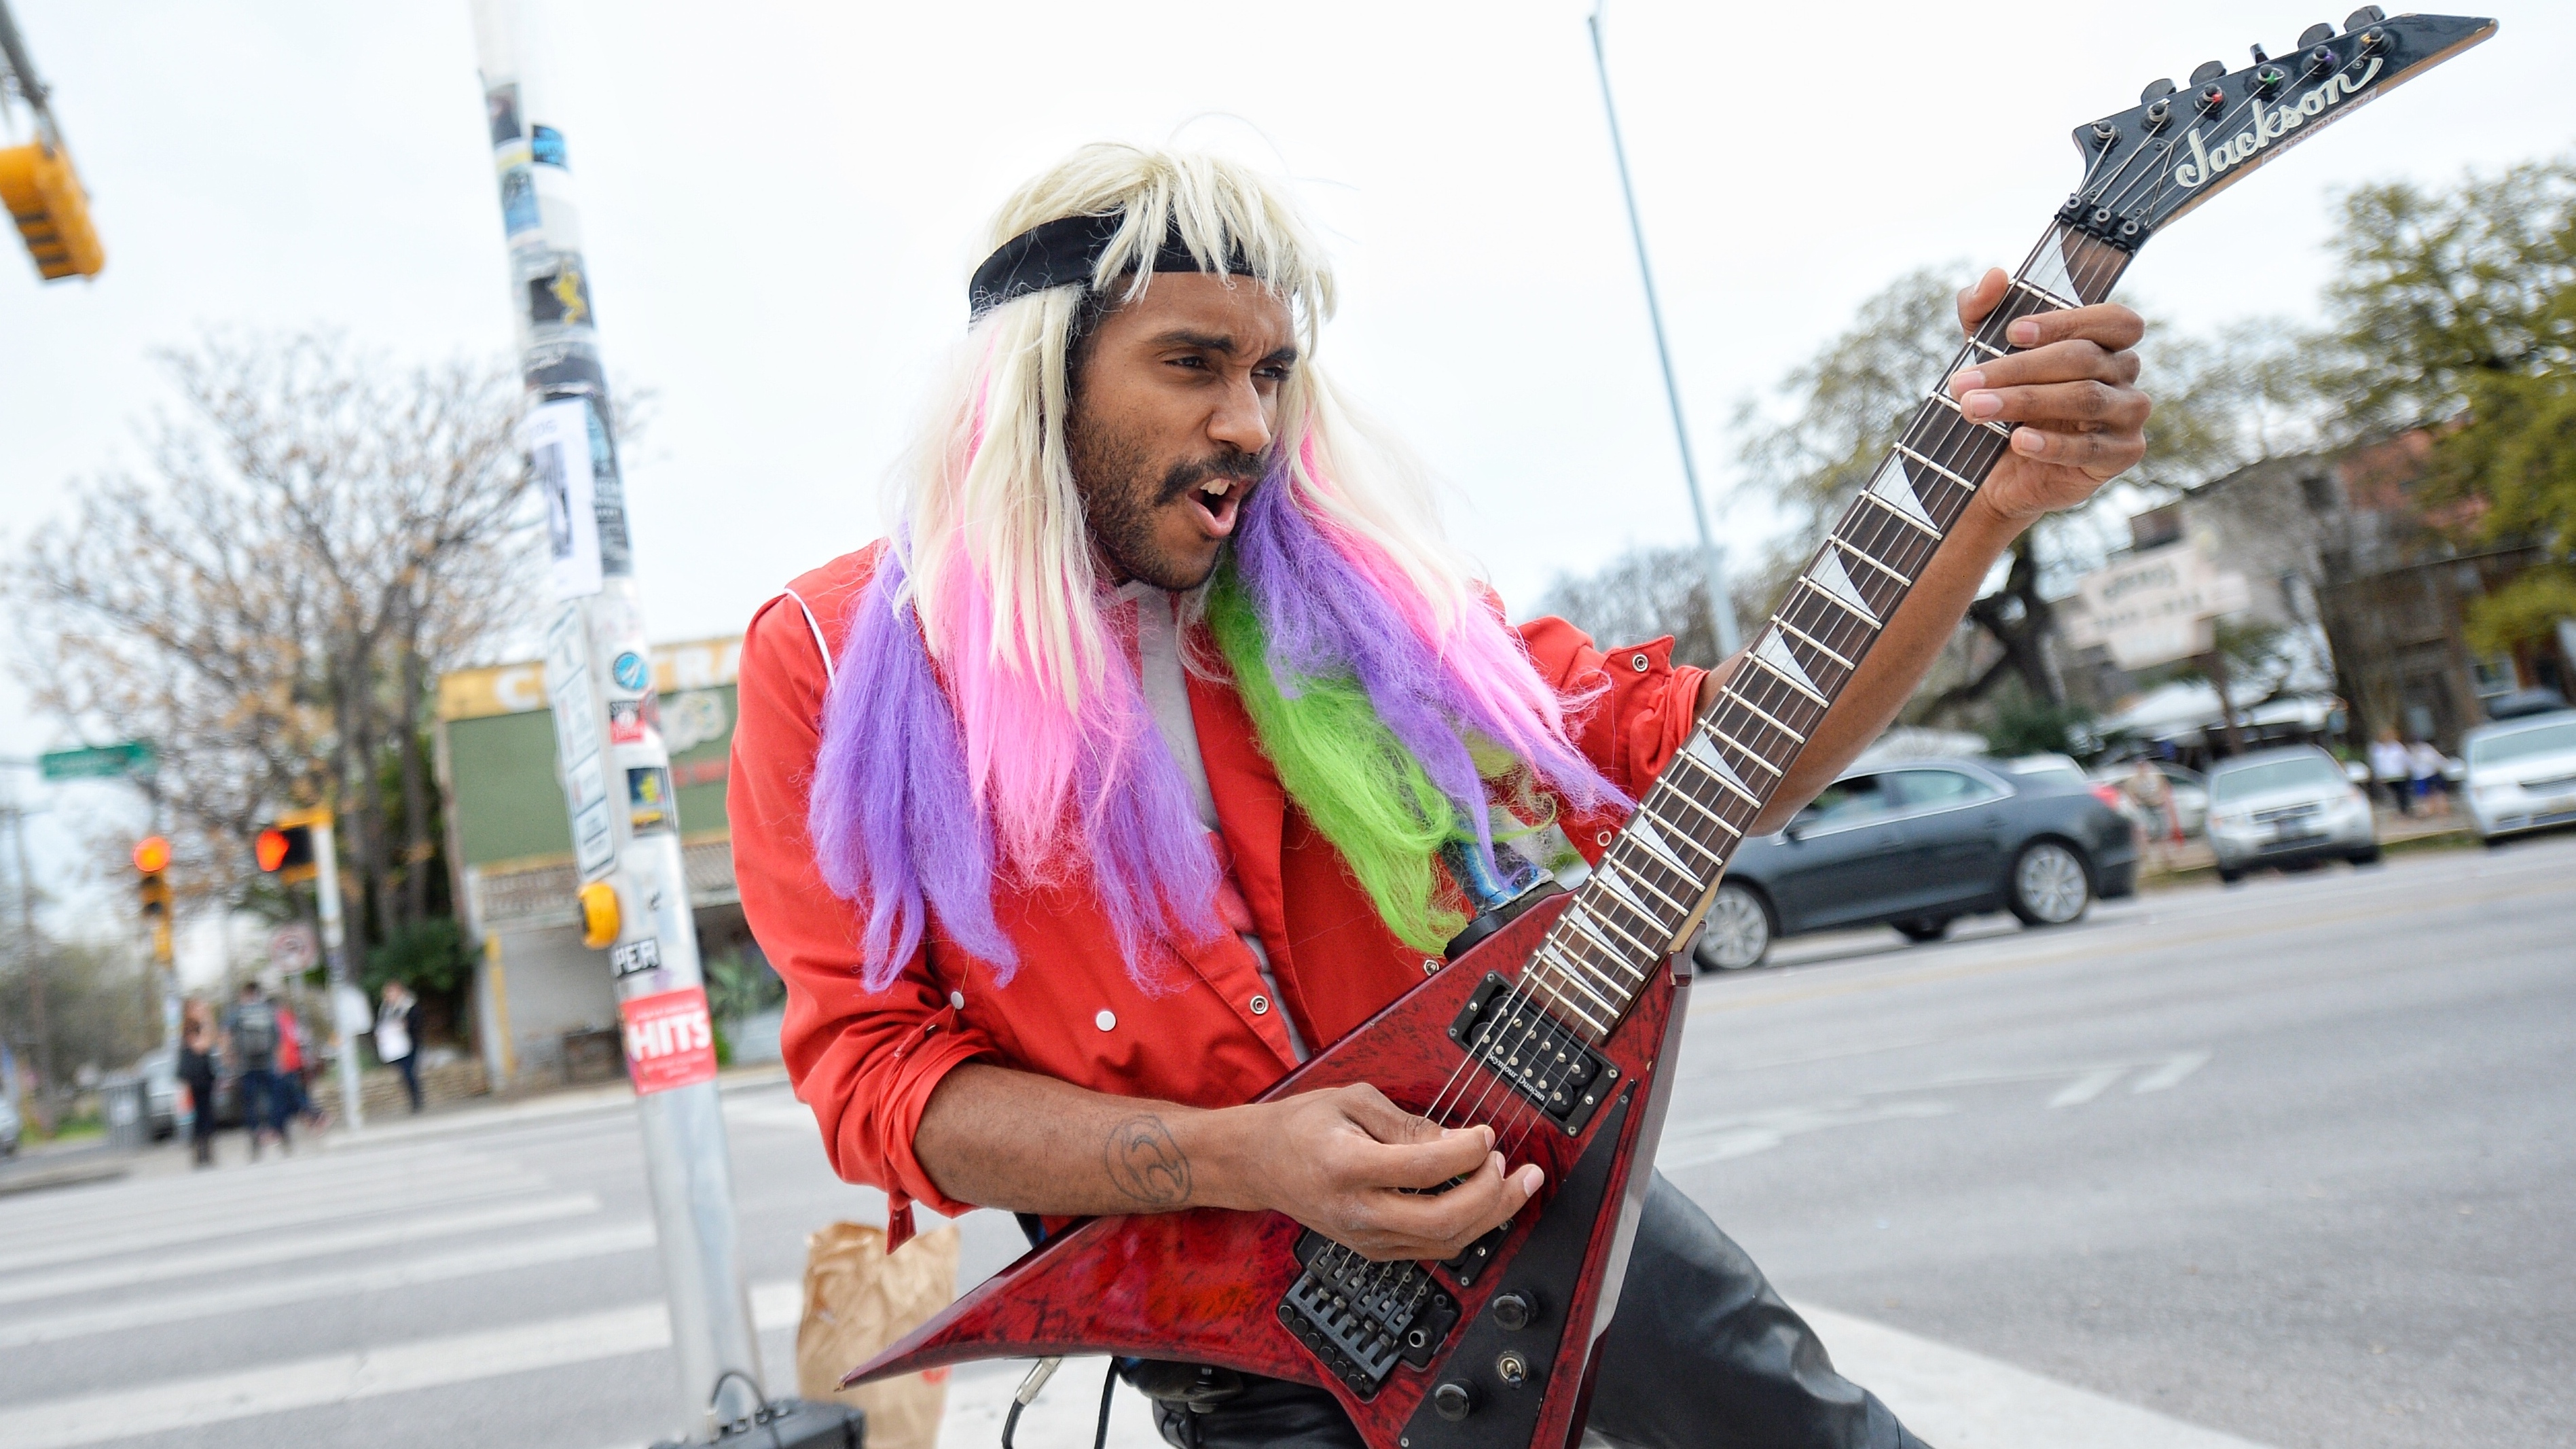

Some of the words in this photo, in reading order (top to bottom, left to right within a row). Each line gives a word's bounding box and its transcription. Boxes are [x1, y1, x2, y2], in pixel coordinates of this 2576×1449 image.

[2175, 57, 2383, 188] Jackson
[627, 1010, 712, 1062] HITS
[1488, 1051, 1519, 1079] Seymour
[1518, 1075, 1546, 1101] Duncan
